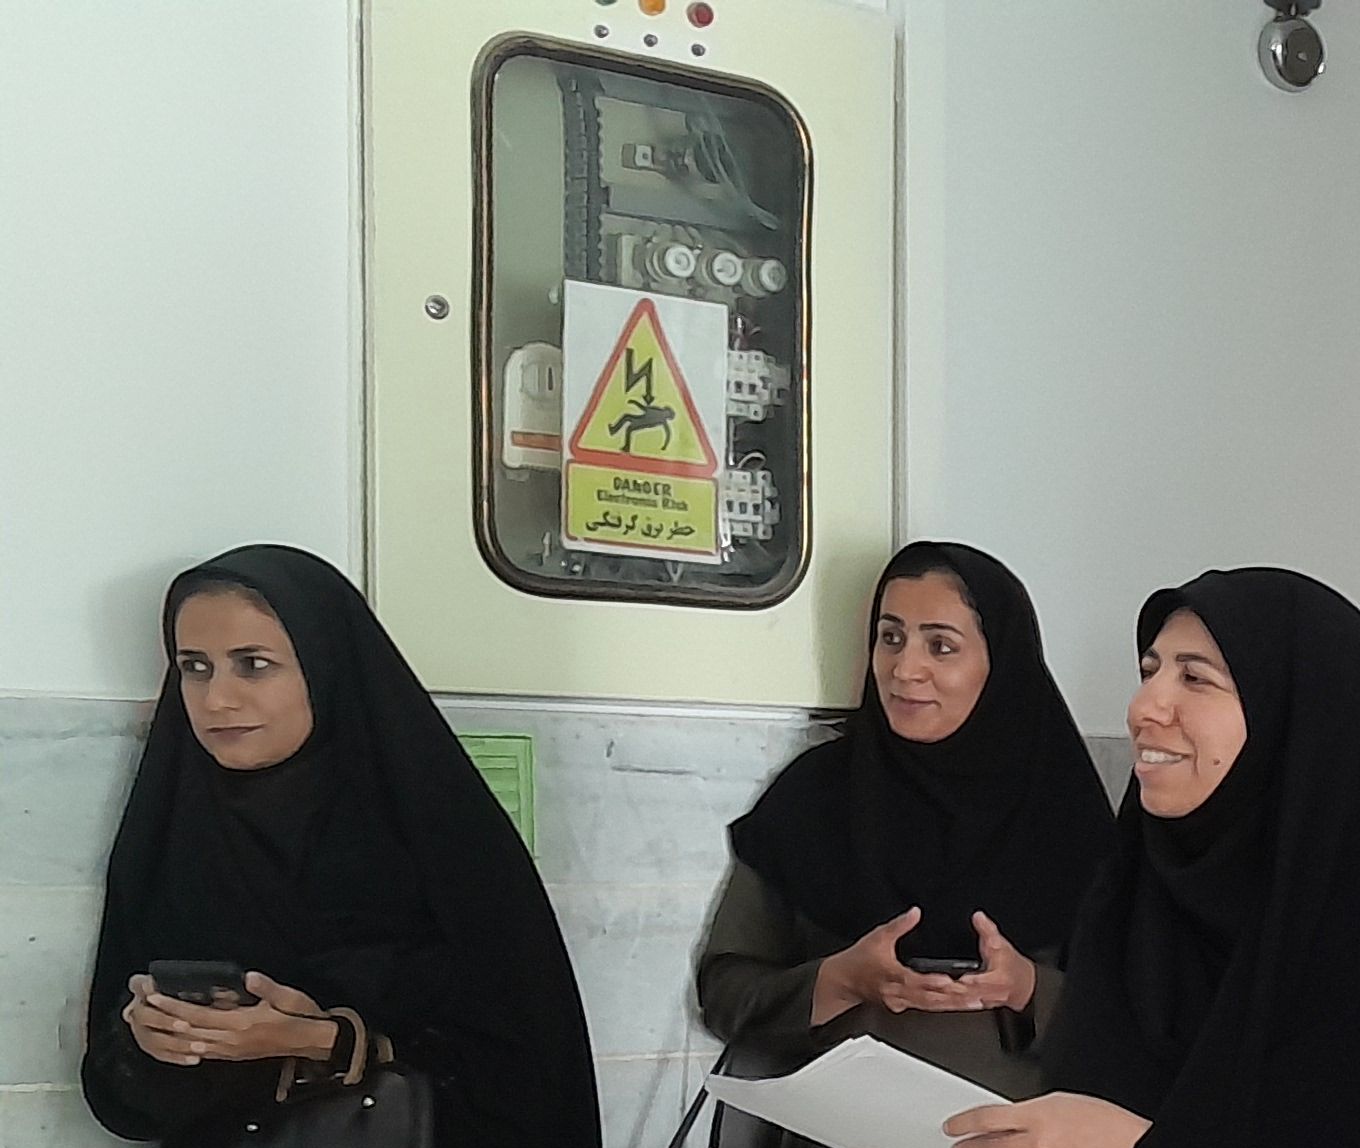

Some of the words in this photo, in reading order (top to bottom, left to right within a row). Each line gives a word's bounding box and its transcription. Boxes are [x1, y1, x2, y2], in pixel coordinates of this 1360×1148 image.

[613, 477, 672, 497] DANGER
[641, 516, 664, 539] برق
[669, 521, 696, 540] خطر
